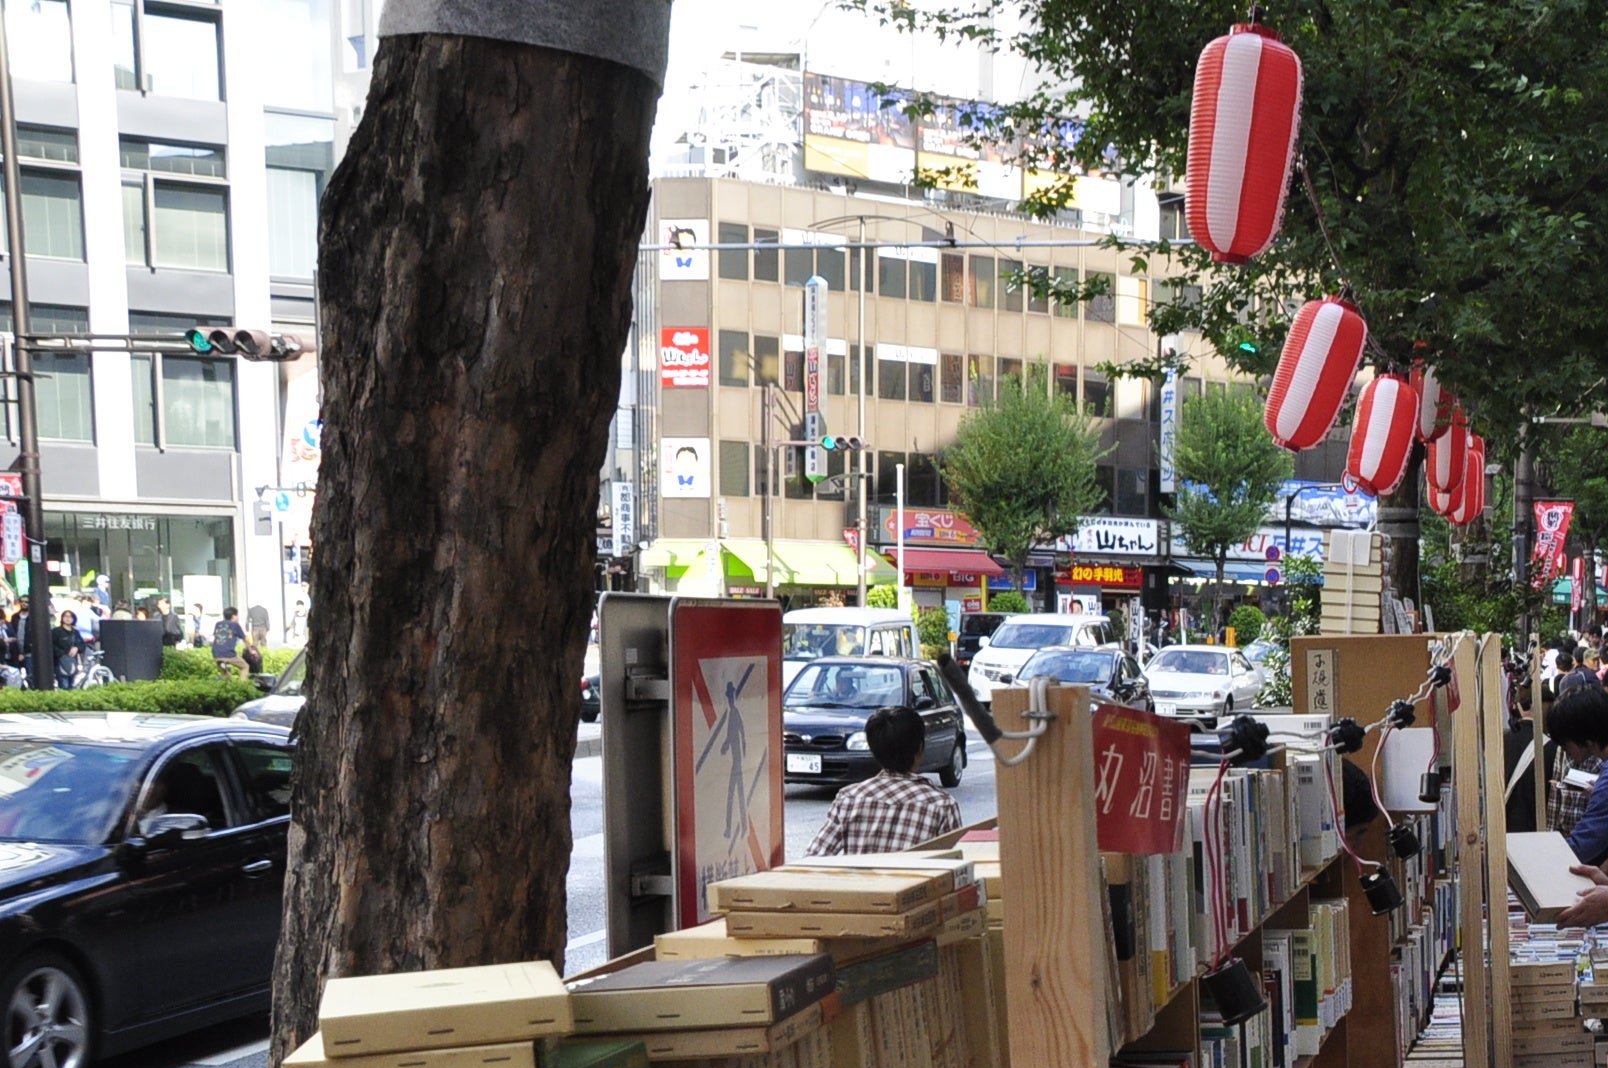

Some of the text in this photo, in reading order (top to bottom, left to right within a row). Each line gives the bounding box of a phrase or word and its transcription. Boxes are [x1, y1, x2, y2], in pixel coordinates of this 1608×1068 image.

[82, 516, 155, 530] 三井住友銀行
[915, 513, 954, 528] 宝くじ
[1096, 529, 1154, 551] 山ちゃん
